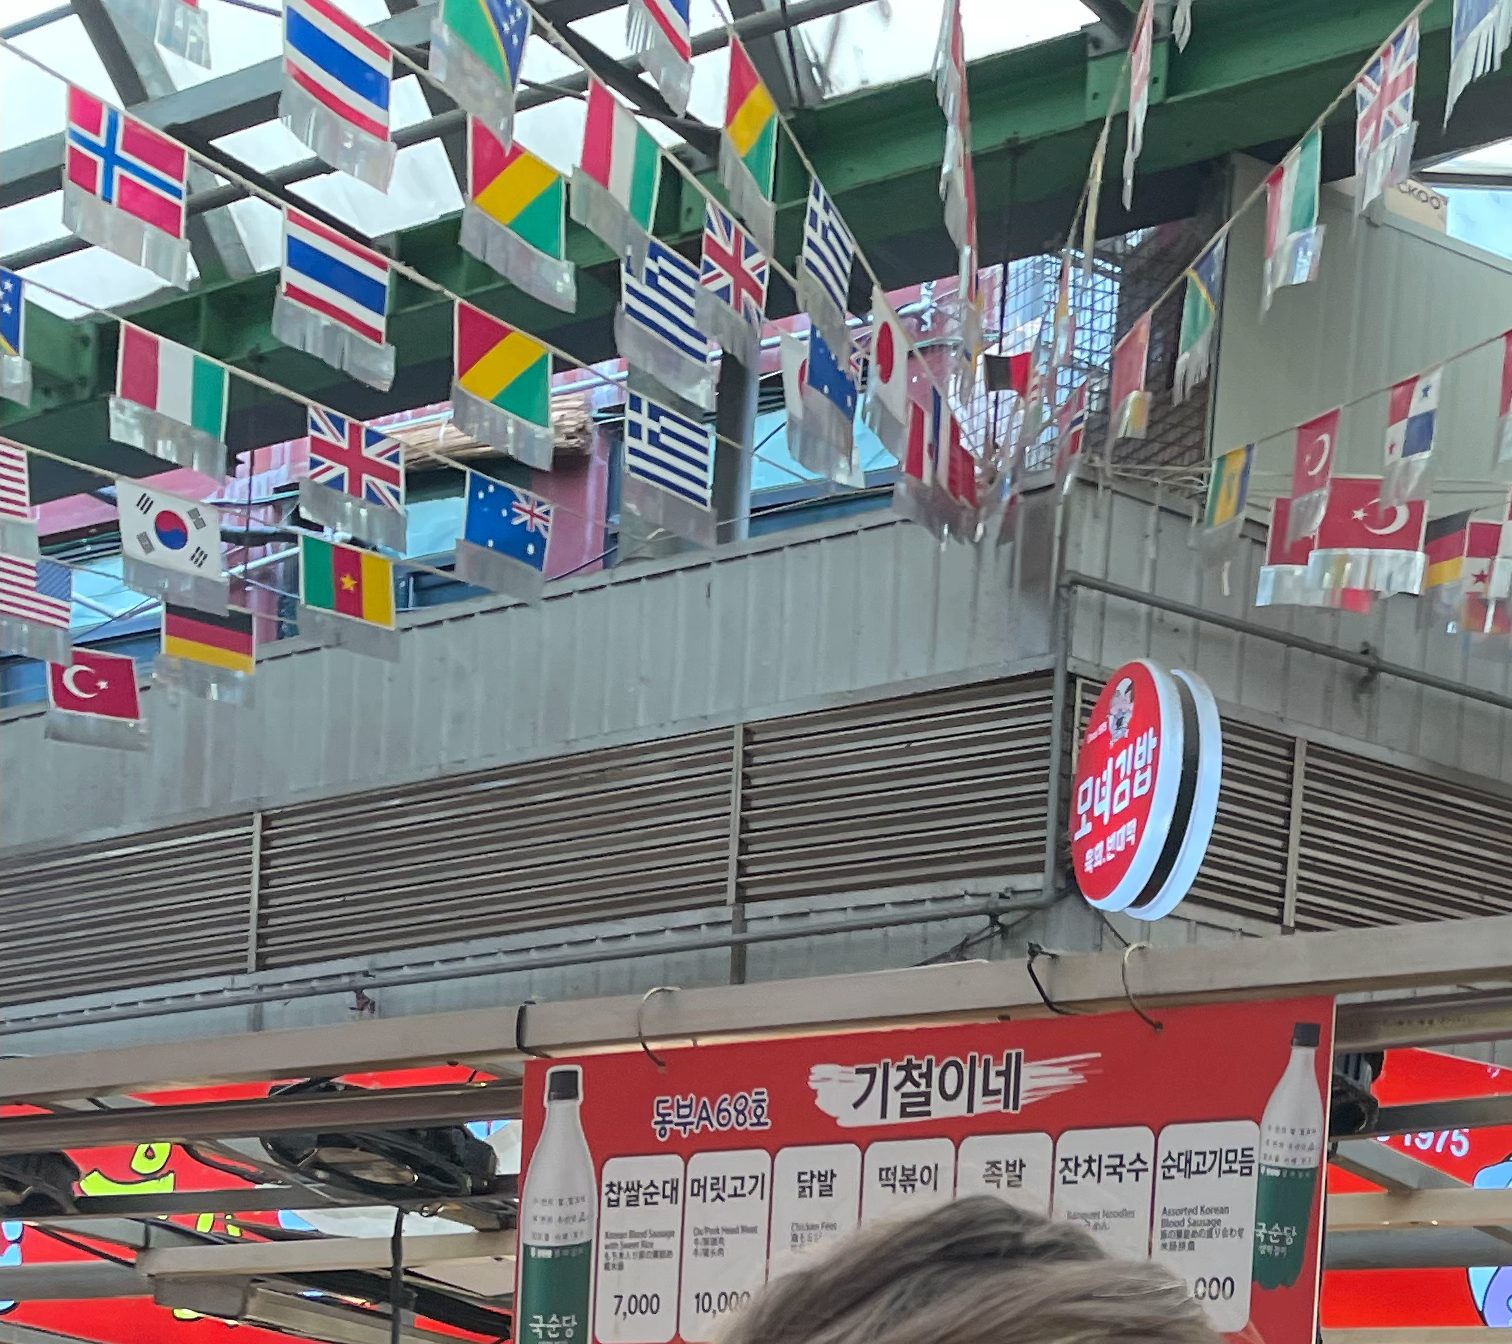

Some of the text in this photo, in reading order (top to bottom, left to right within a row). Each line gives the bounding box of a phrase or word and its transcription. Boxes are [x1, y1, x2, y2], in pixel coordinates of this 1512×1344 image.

[1074, 727, 1157, 841] 모녀김밥
[852, 1049, 1023, 1119] 기철이네
[652, 1088, 770, 1140] 동부A68호
[878, 1163, 939, 1194] 떡볶이
[982, 1158, 1026, 1189] 족발
[1058, 1152, 1149, 1186] 잔치국수
[1160, 1146, 1256, 1180] 순대고기모듬
[604, 1177, 679, 1208] 찹쌀순대
[690, 1172, 766, 1203] 머릿고기
[797, 1168, 837, 1199] 닭발
[1161, 1204, 1229, 1216] Assorted Korean
[1255, 1222, 1297, 1245] 국순당
[613, 1292, 660, 1320] 7,000
[694, 1290, 752, 1318] 10,000
[528, 1313, 578, 1338] 국순당
